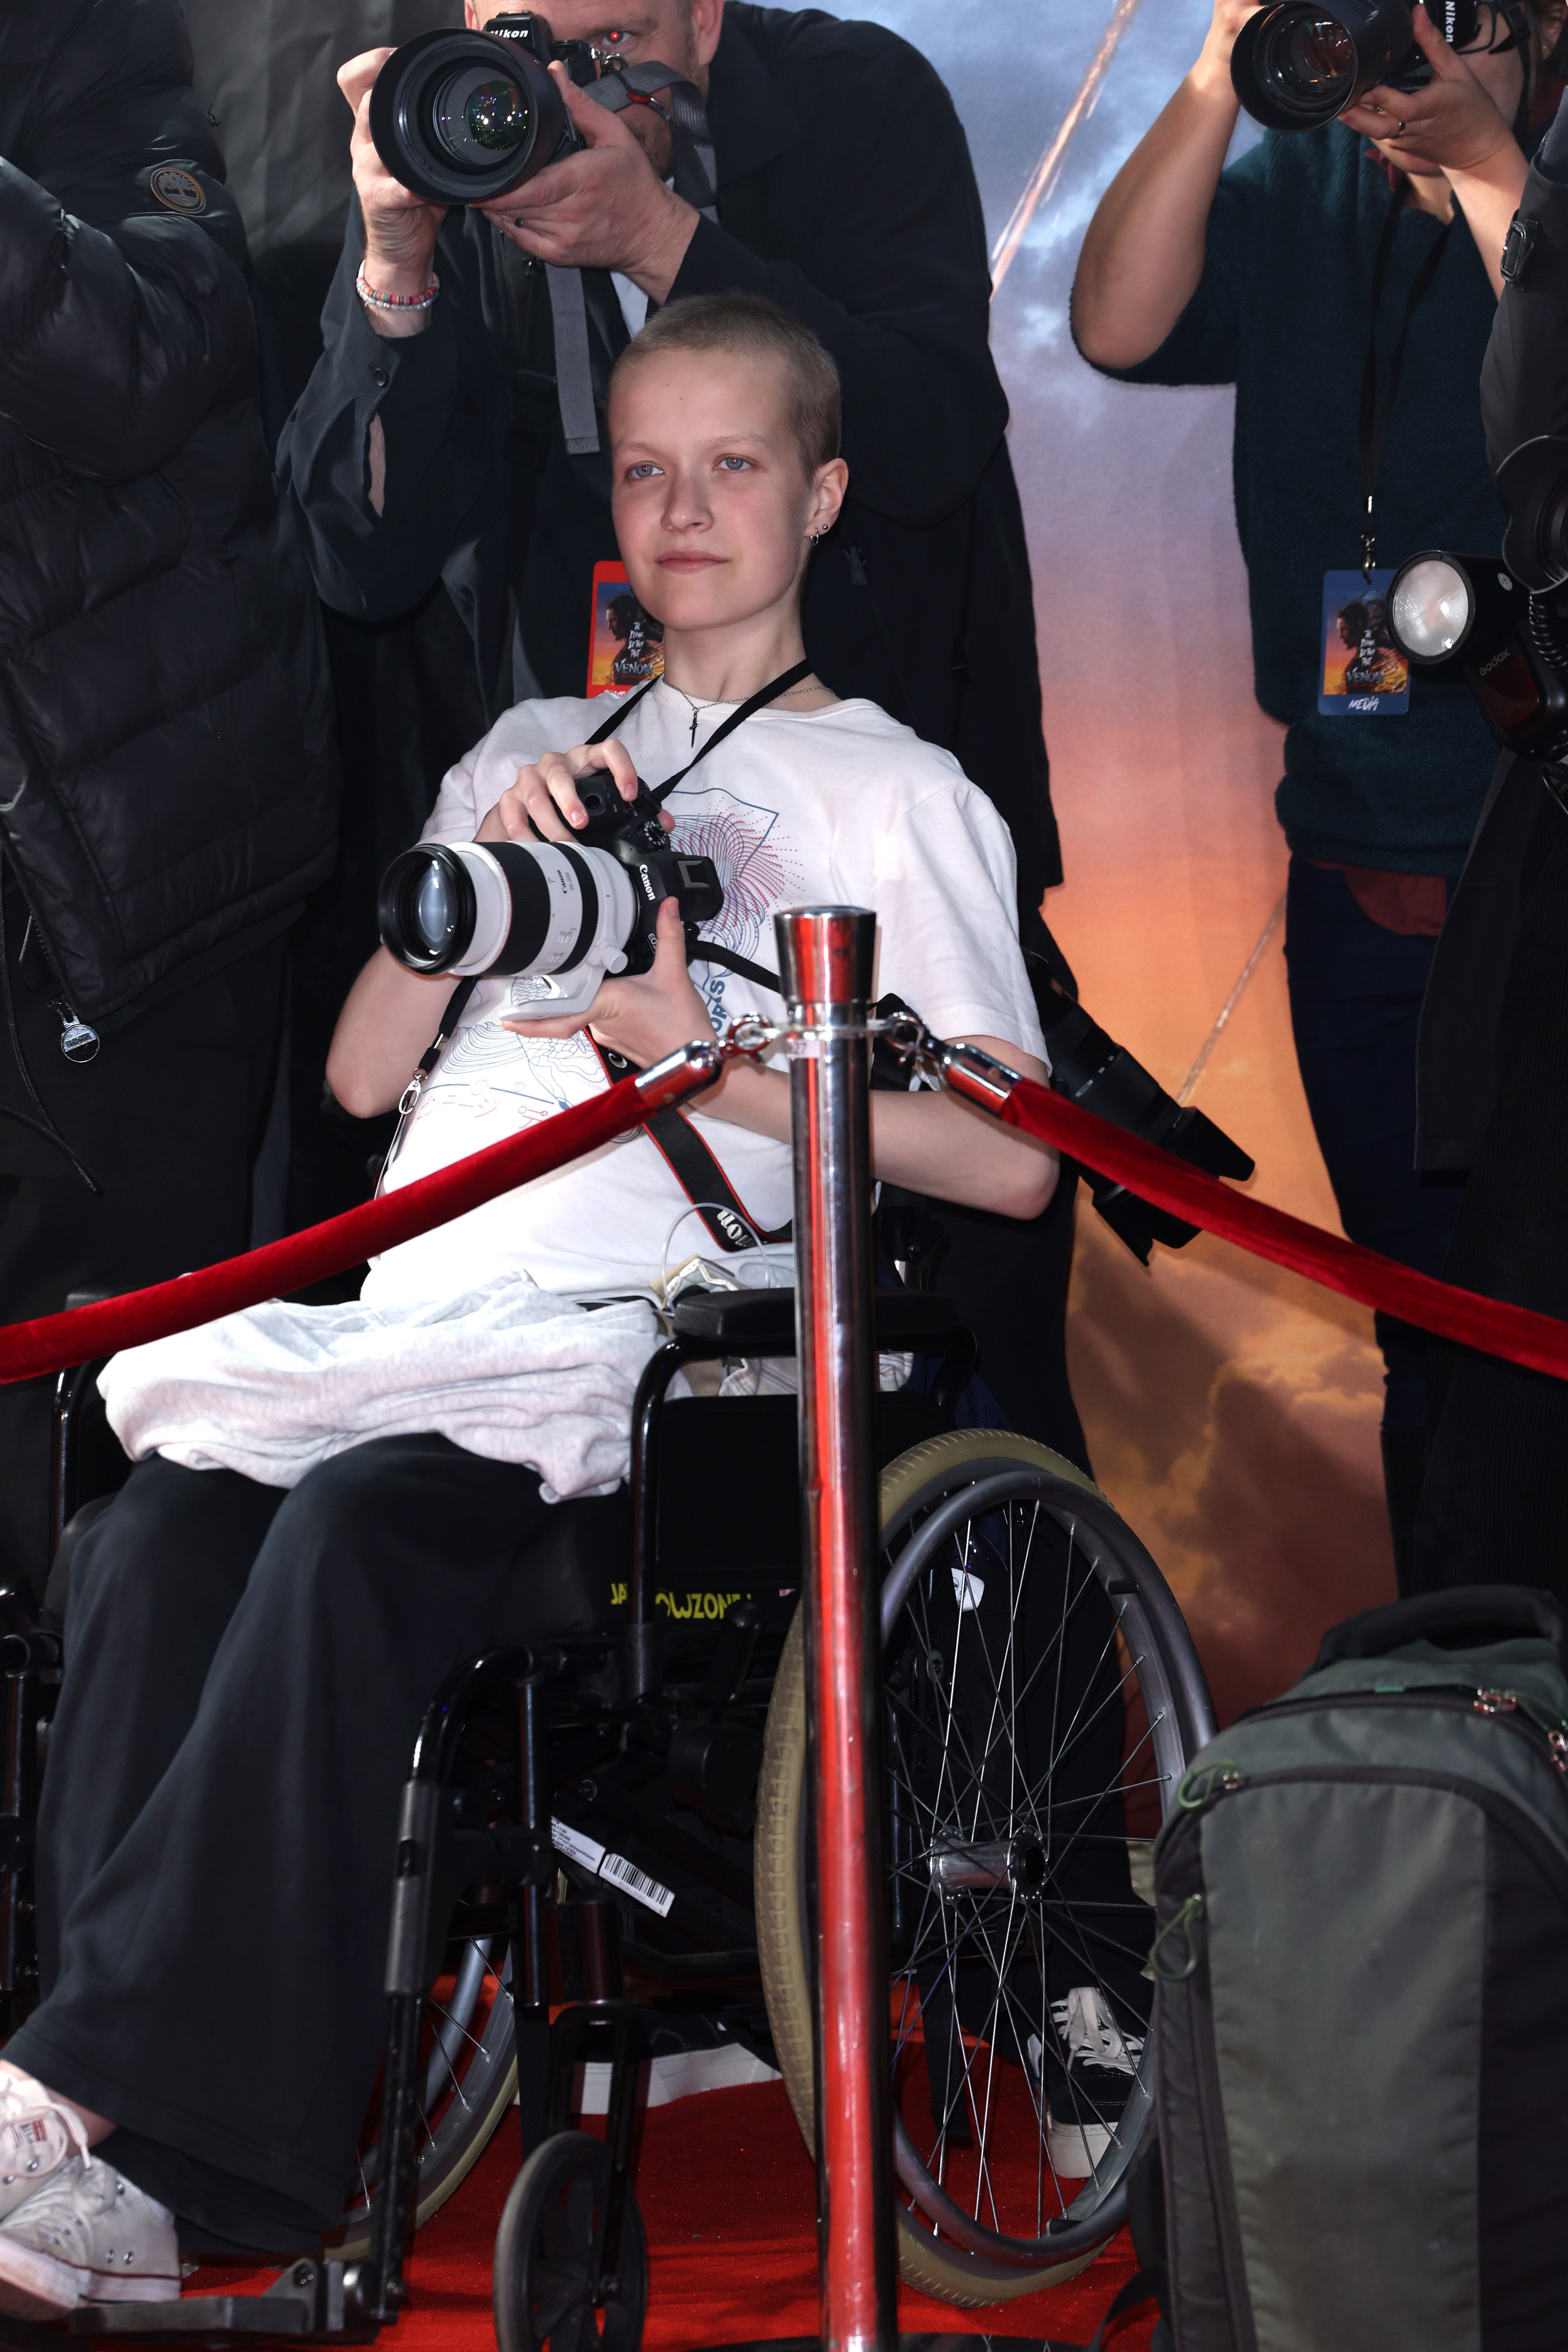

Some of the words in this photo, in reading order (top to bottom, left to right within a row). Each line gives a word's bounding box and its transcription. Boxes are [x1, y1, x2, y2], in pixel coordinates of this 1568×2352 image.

[1445, 1, 1455, 42] Nikon
[615, 658, 653, 677] VENOM
[1480, 648, 1510, 676] Godox
[1346, 666, 1385, 684] VENOM
[1348, 695, 1379, 711] MEDIA
[557, 870, 567, 894] Canon
[639, 864, 656, 901] Canon
[648, 933, 658, 949] EO
